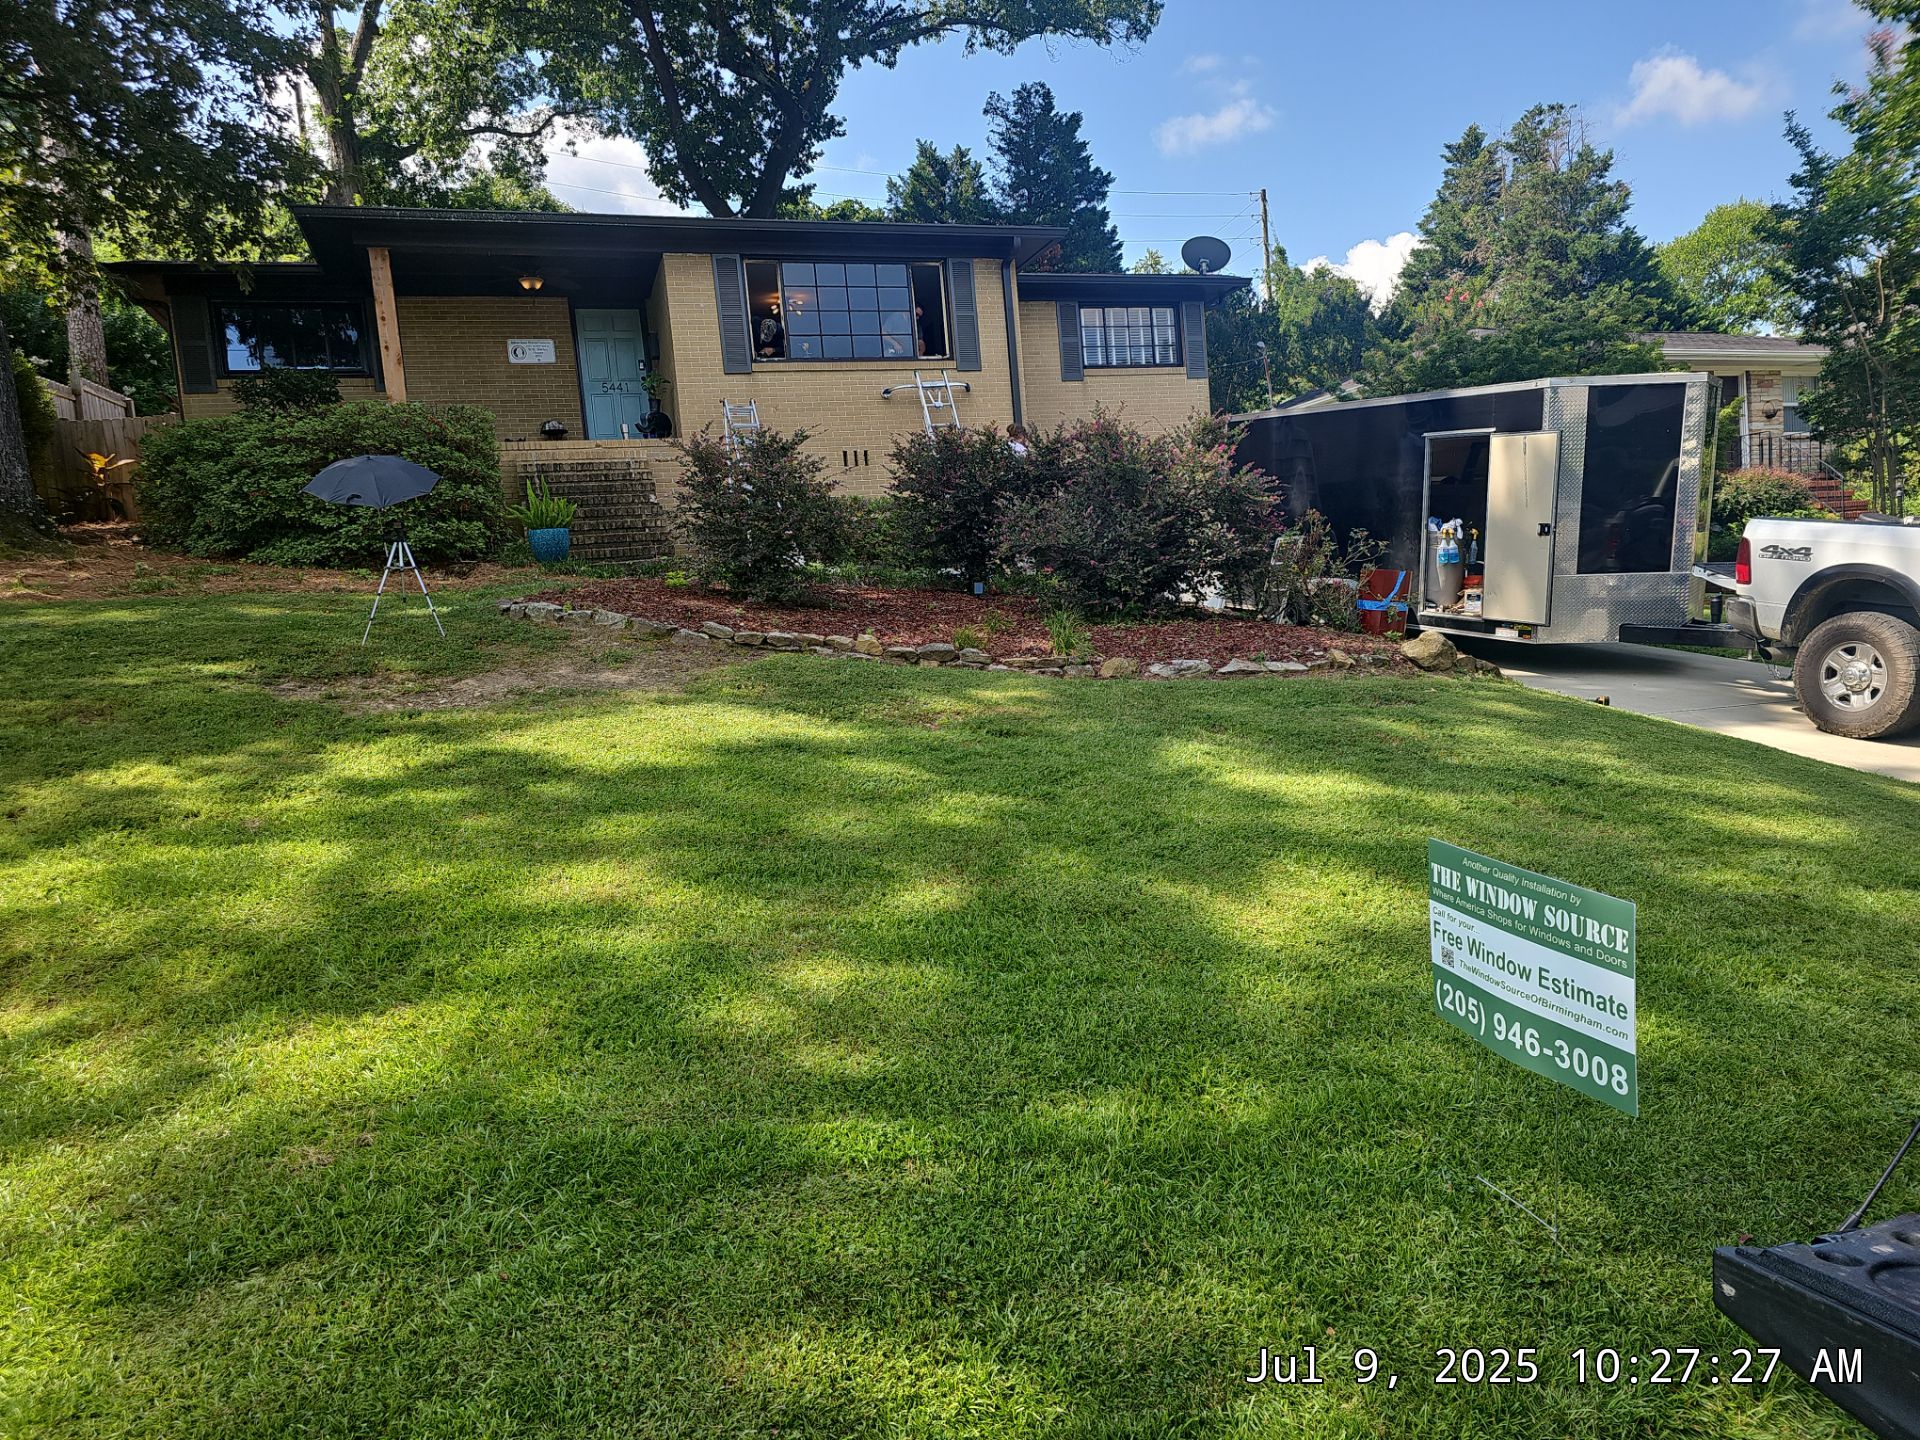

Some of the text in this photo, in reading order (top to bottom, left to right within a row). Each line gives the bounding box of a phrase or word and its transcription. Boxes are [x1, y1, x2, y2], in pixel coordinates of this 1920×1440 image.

[601, 382, 630, 393] 5441
[1431, 862, 1629, 954] THE WINDOW SOURCE
[1432, 906, 1446, 919] Call
[1446, 912, 1457, 923] for
[1462, 857, 1582, 907] Another Quality Installation by
[1432, 886, 1628, 969] Where America Shops for Windows and Doors
[1433, 920, 1628, 1021] Free Window Estimate
[1459, 958, 1629, 1041] TheWindowSourceOfBirmingham.com
[1436, 978, 1629, 1096] (205) 946-3008
